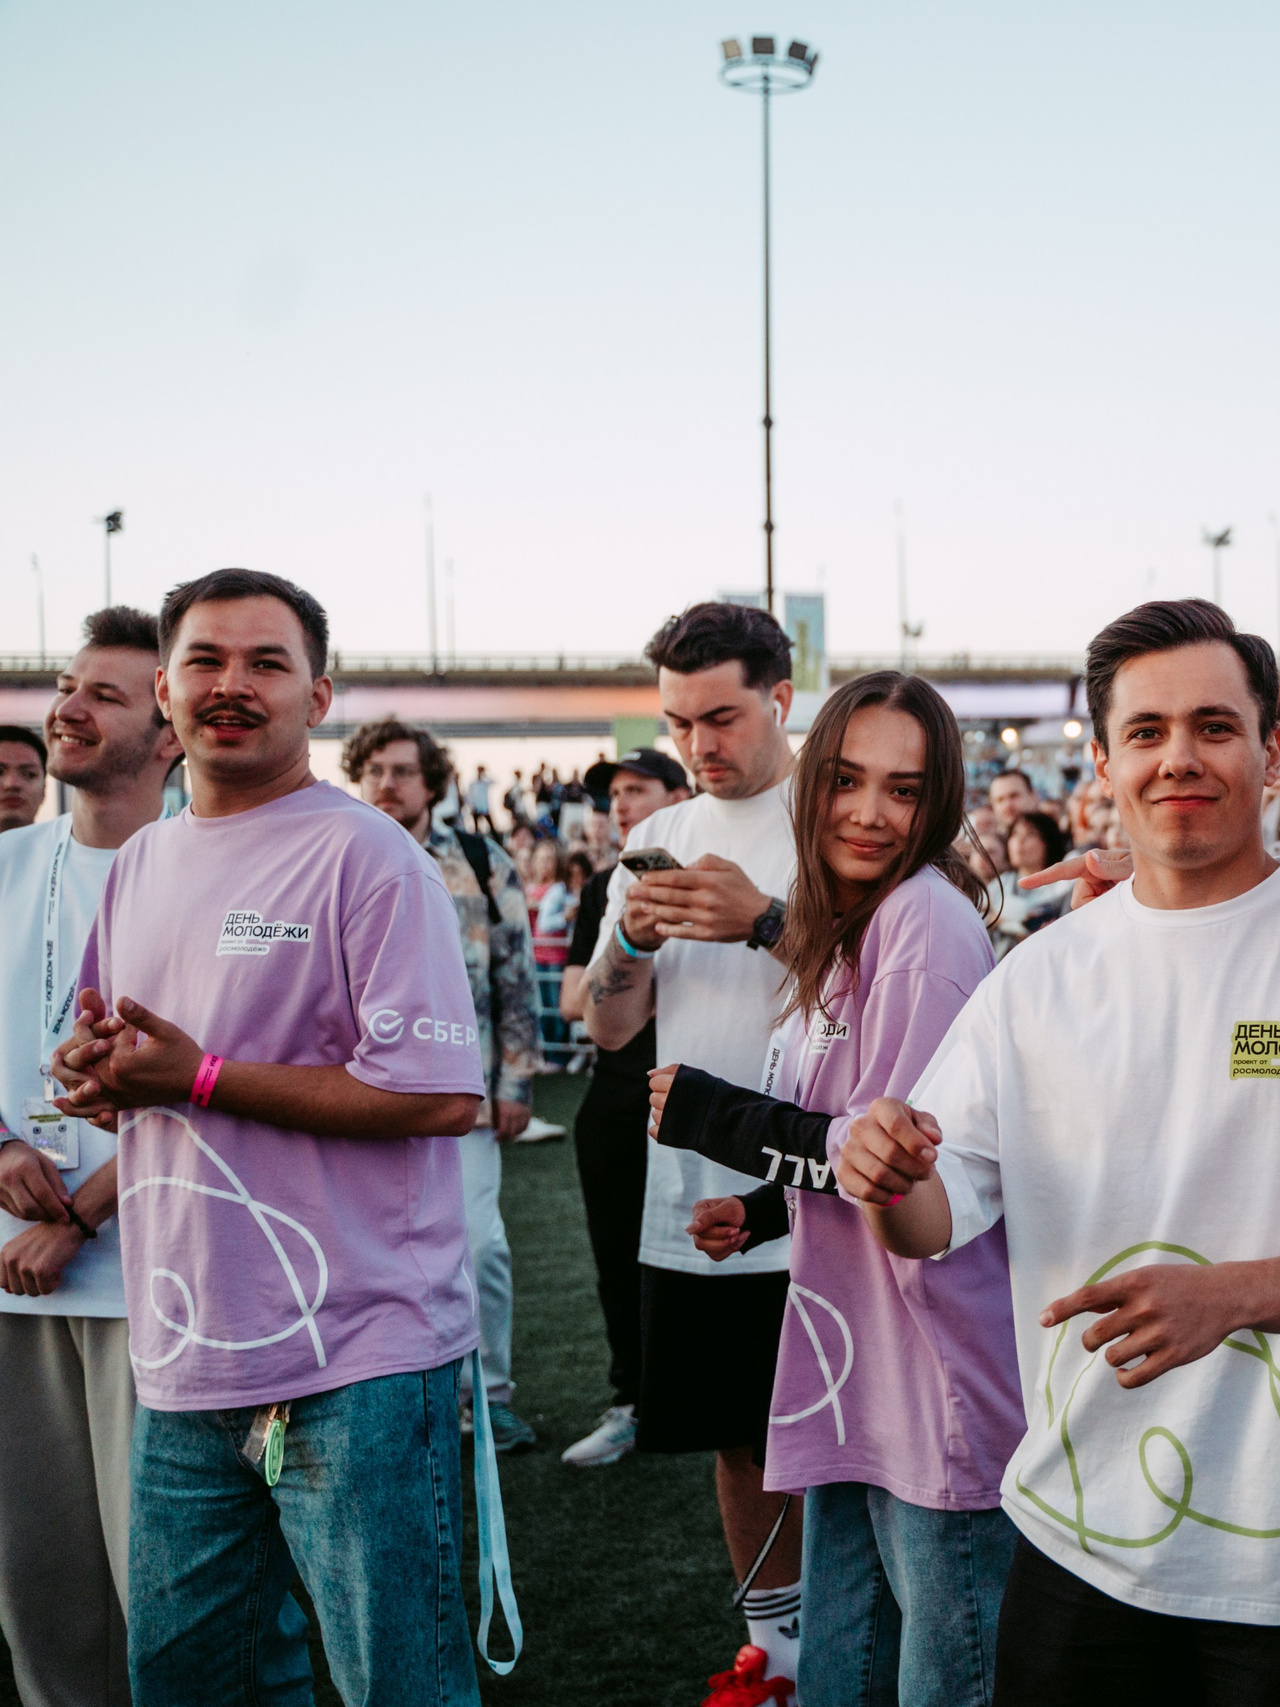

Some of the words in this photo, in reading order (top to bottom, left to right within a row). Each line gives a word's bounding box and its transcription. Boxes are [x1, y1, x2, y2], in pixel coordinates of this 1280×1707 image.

[225, 913, 260, 925] ДЕНЬ
[222, 923, 309, 939] МОЛОДЁЖИ
[412, 1017, 476, 1046] СБЕР
[769, 1048, 780, 1071] ДЕНЬ
